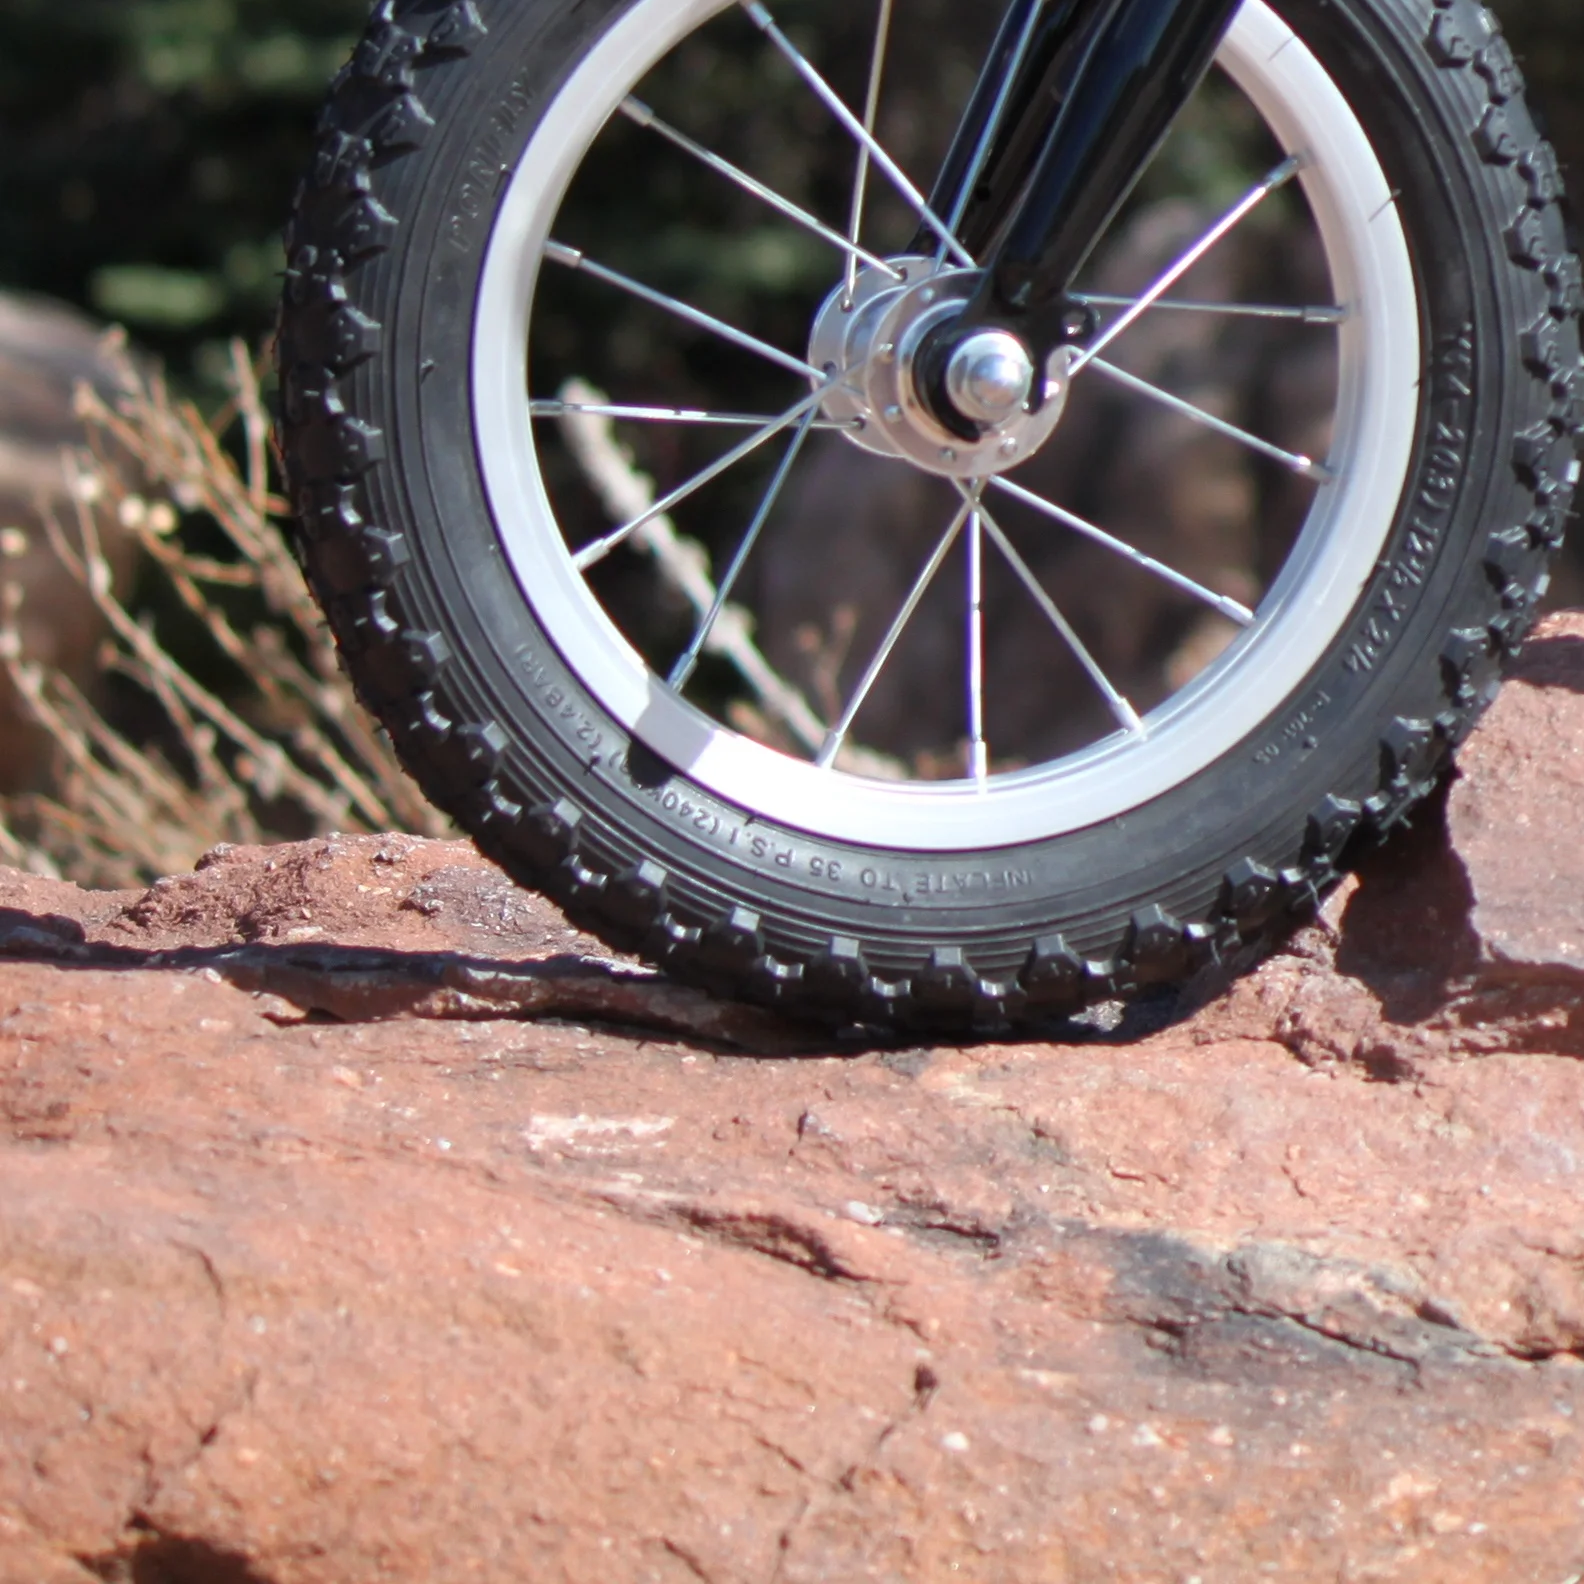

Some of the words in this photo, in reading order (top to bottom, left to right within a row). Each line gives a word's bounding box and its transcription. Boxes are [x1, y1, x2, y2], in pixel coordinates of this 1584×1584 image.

[806, 854, 843, 881] 35
[858, 866, 898, 890] TO
[913, 865, 1032, 894] INFLATE
